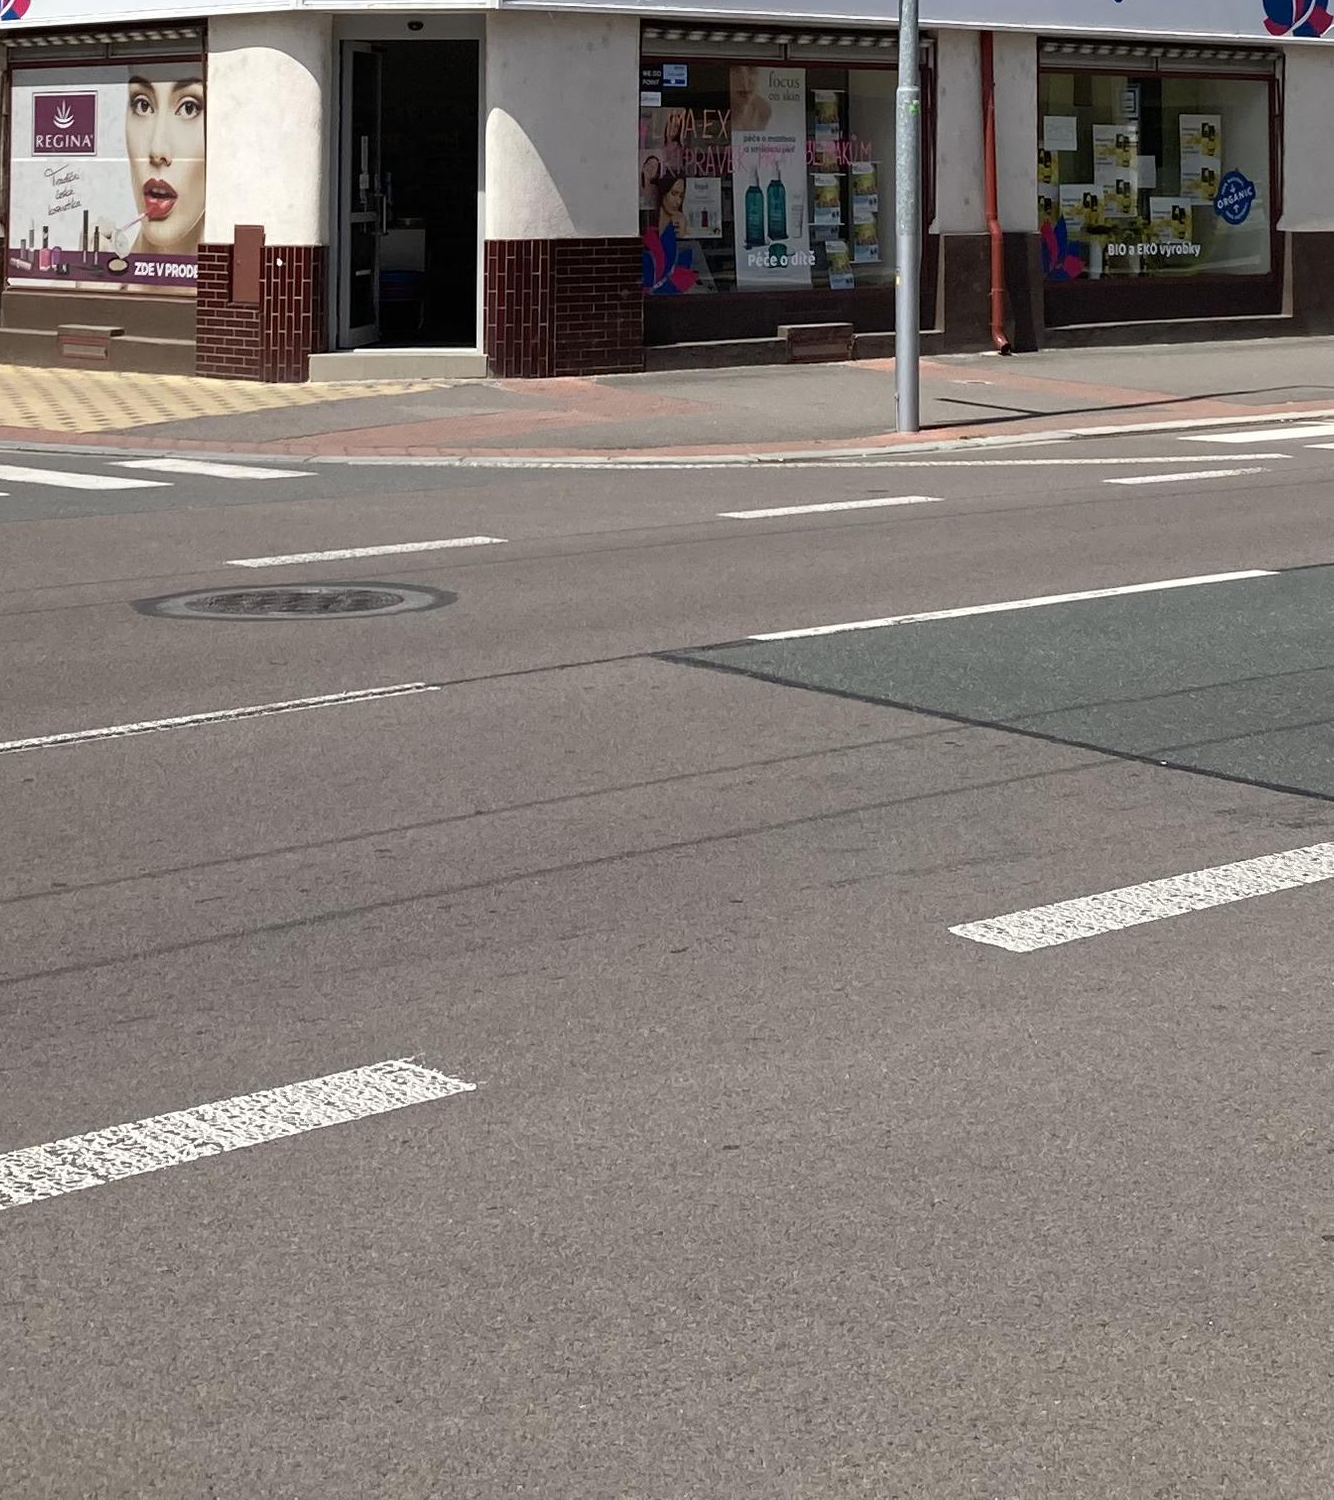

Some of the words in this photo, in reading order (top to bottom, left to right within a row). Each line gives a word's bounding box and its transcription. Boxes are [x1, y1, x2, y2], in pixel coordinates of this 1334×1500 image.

[769, 71, 800, 88] focus
[768, 92, 780, 101] on
[36, 134, 92, 148] REGINA
[1217, 186, 1253, 209] ORGANIC
[1107, 243, 1126, 256] BIO
[1128, 245, 1135, 256] a
[1137, 243, 1157, 256] EKO
[1159, 241, 1201, 257] výrobky
[748, 250, 778, 267] Péče
[779, 255, 788, 267] o
[791, 250, 816, 267] dítě
[134, 262, 155, 276] ZDE
[156, 263, 165, 277] V
